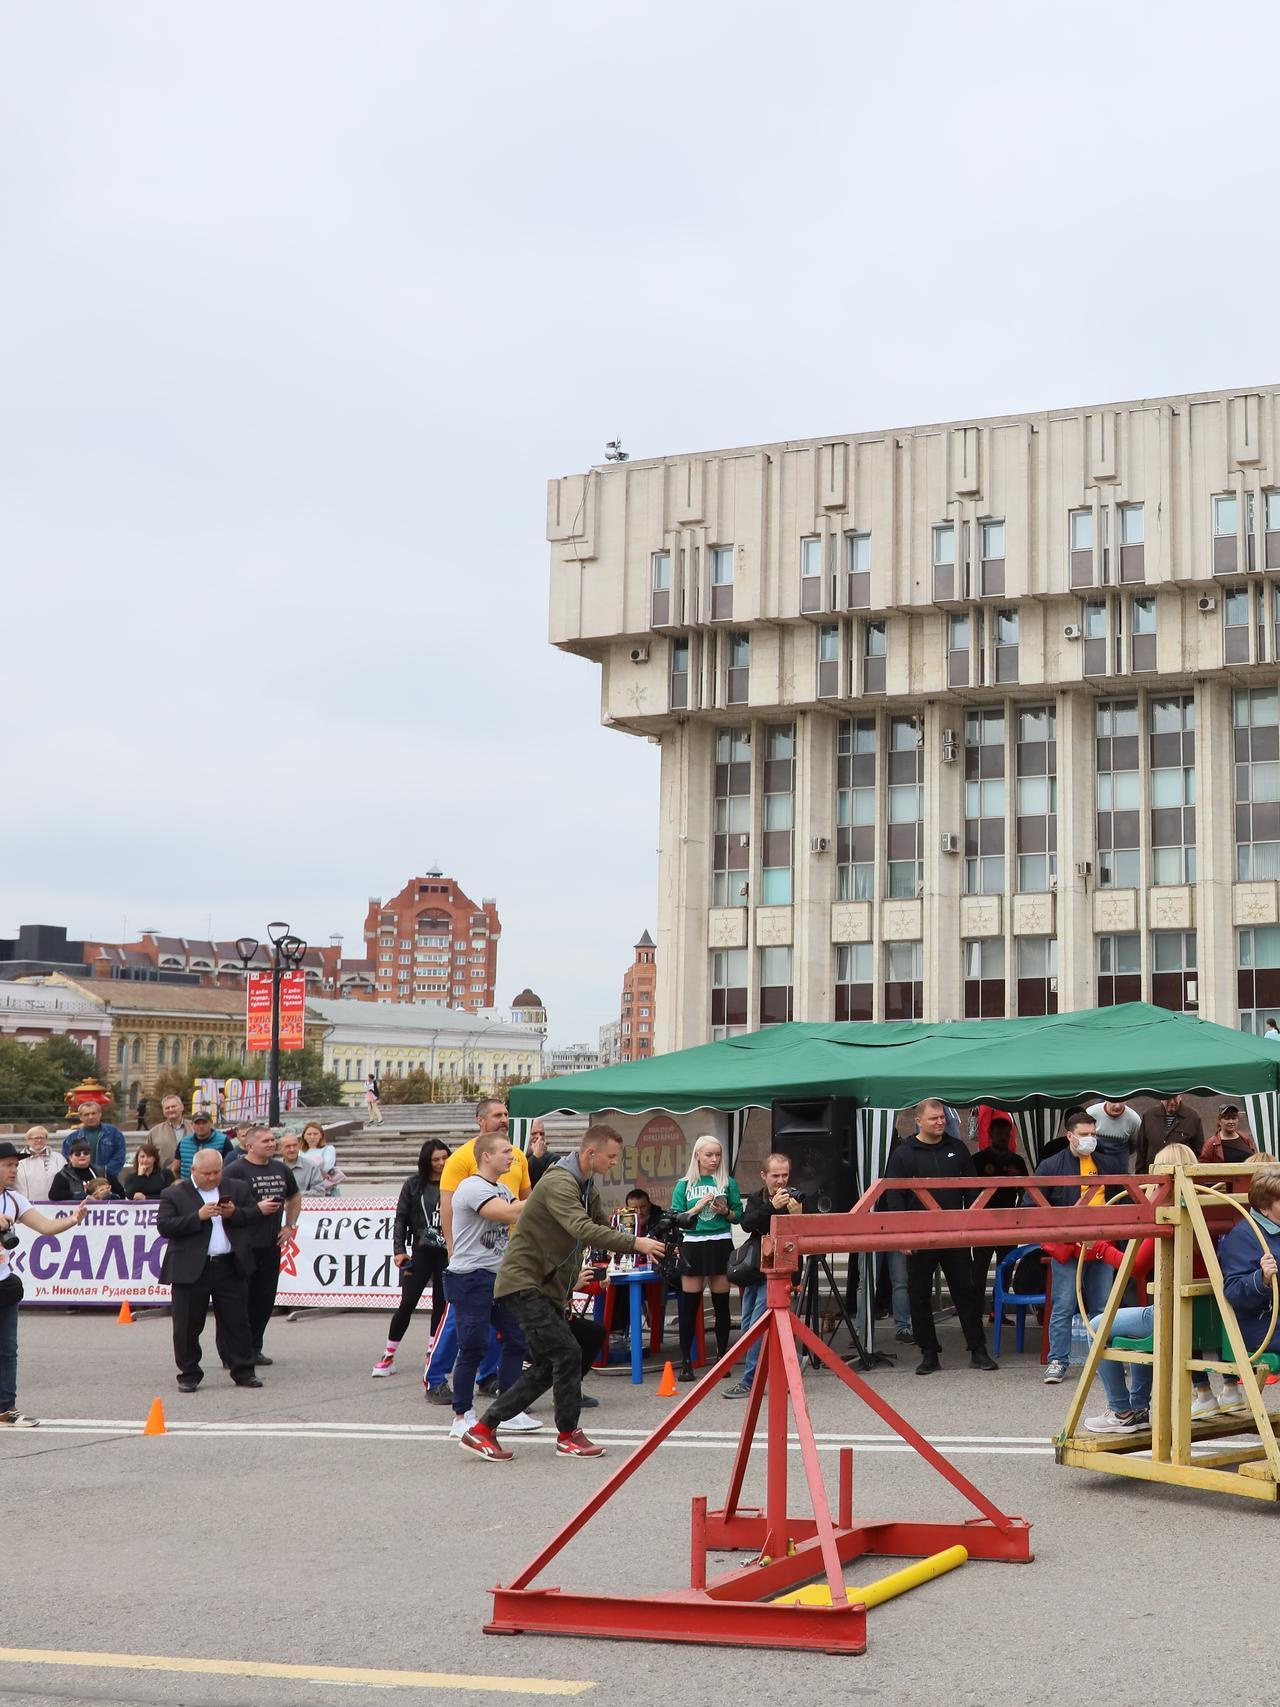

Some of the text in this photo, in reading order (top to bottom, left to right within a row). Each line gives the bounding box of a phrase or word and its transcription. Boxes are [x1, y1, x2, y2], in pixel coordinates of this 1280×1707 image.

[314, 1217, 397, 1240] ВРЕМ
[313, 1254, 401, 1287] СИЛ
[35, 1286, 50, 1296] ул.
[52, 1285, 98, 1295] Николая
[101, 1286, 146, 1297] Руднева
